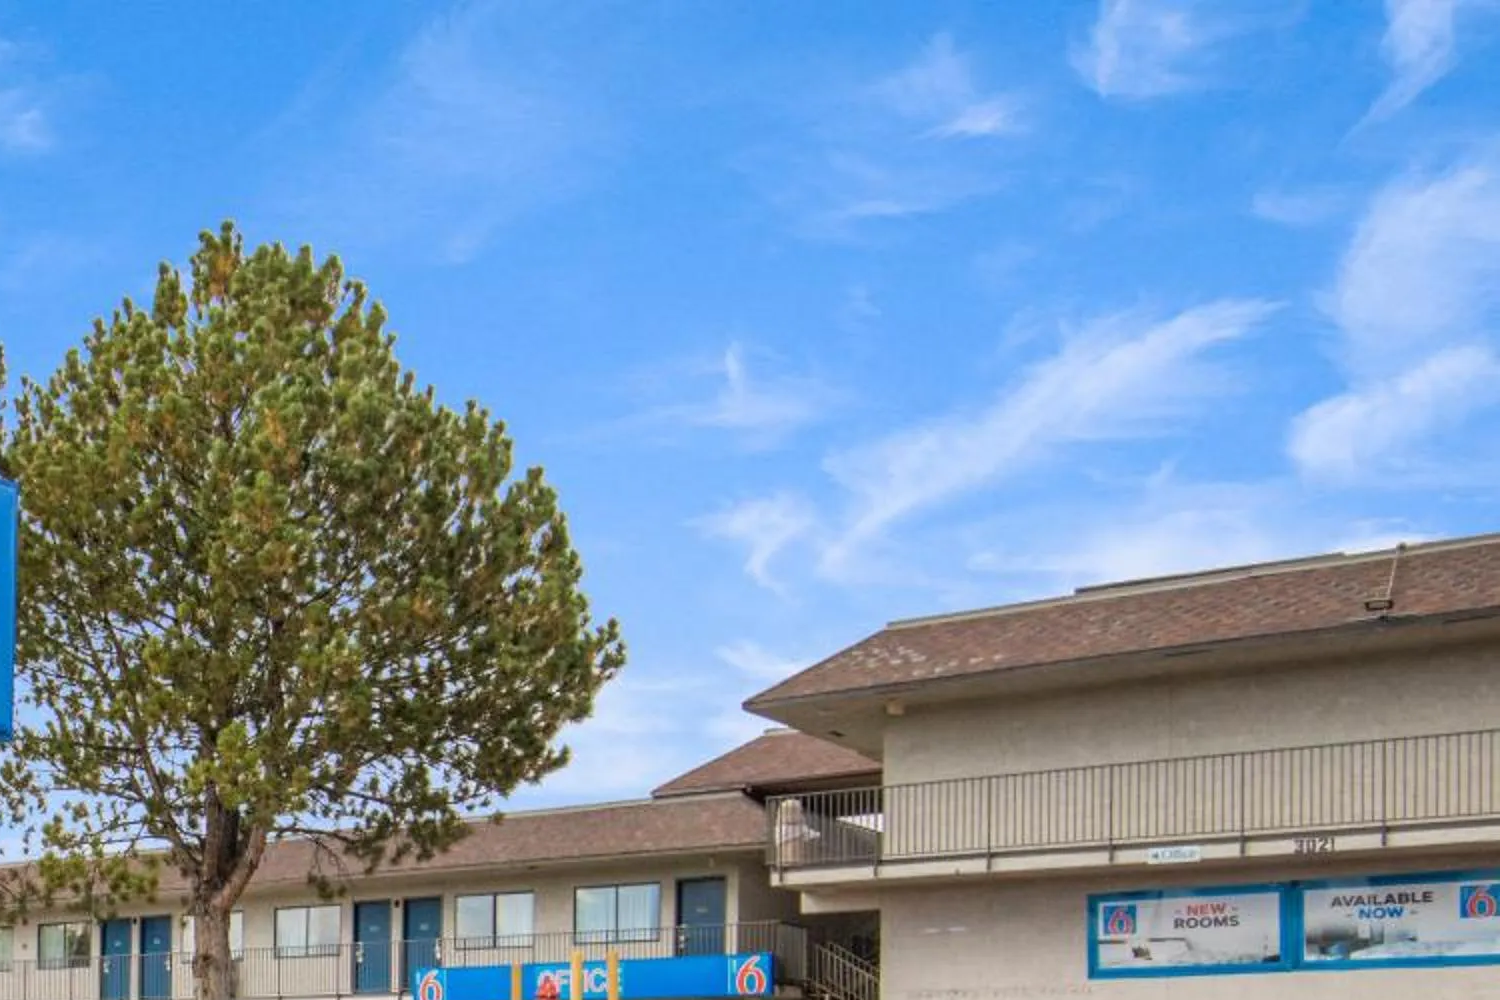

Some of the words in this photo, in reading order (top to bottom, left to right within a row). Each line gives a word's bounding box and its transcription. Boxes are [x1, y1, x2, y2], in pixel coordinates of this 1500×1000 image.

[1330, 890, 1434, 908] AVAILABLE
[1186, 903, 1227, 916] NEW
[1358, 906, 1405, 919] NOW
[1174, 915, 1240, 929] ROOMS
[736, 955, 766, 994] 6
